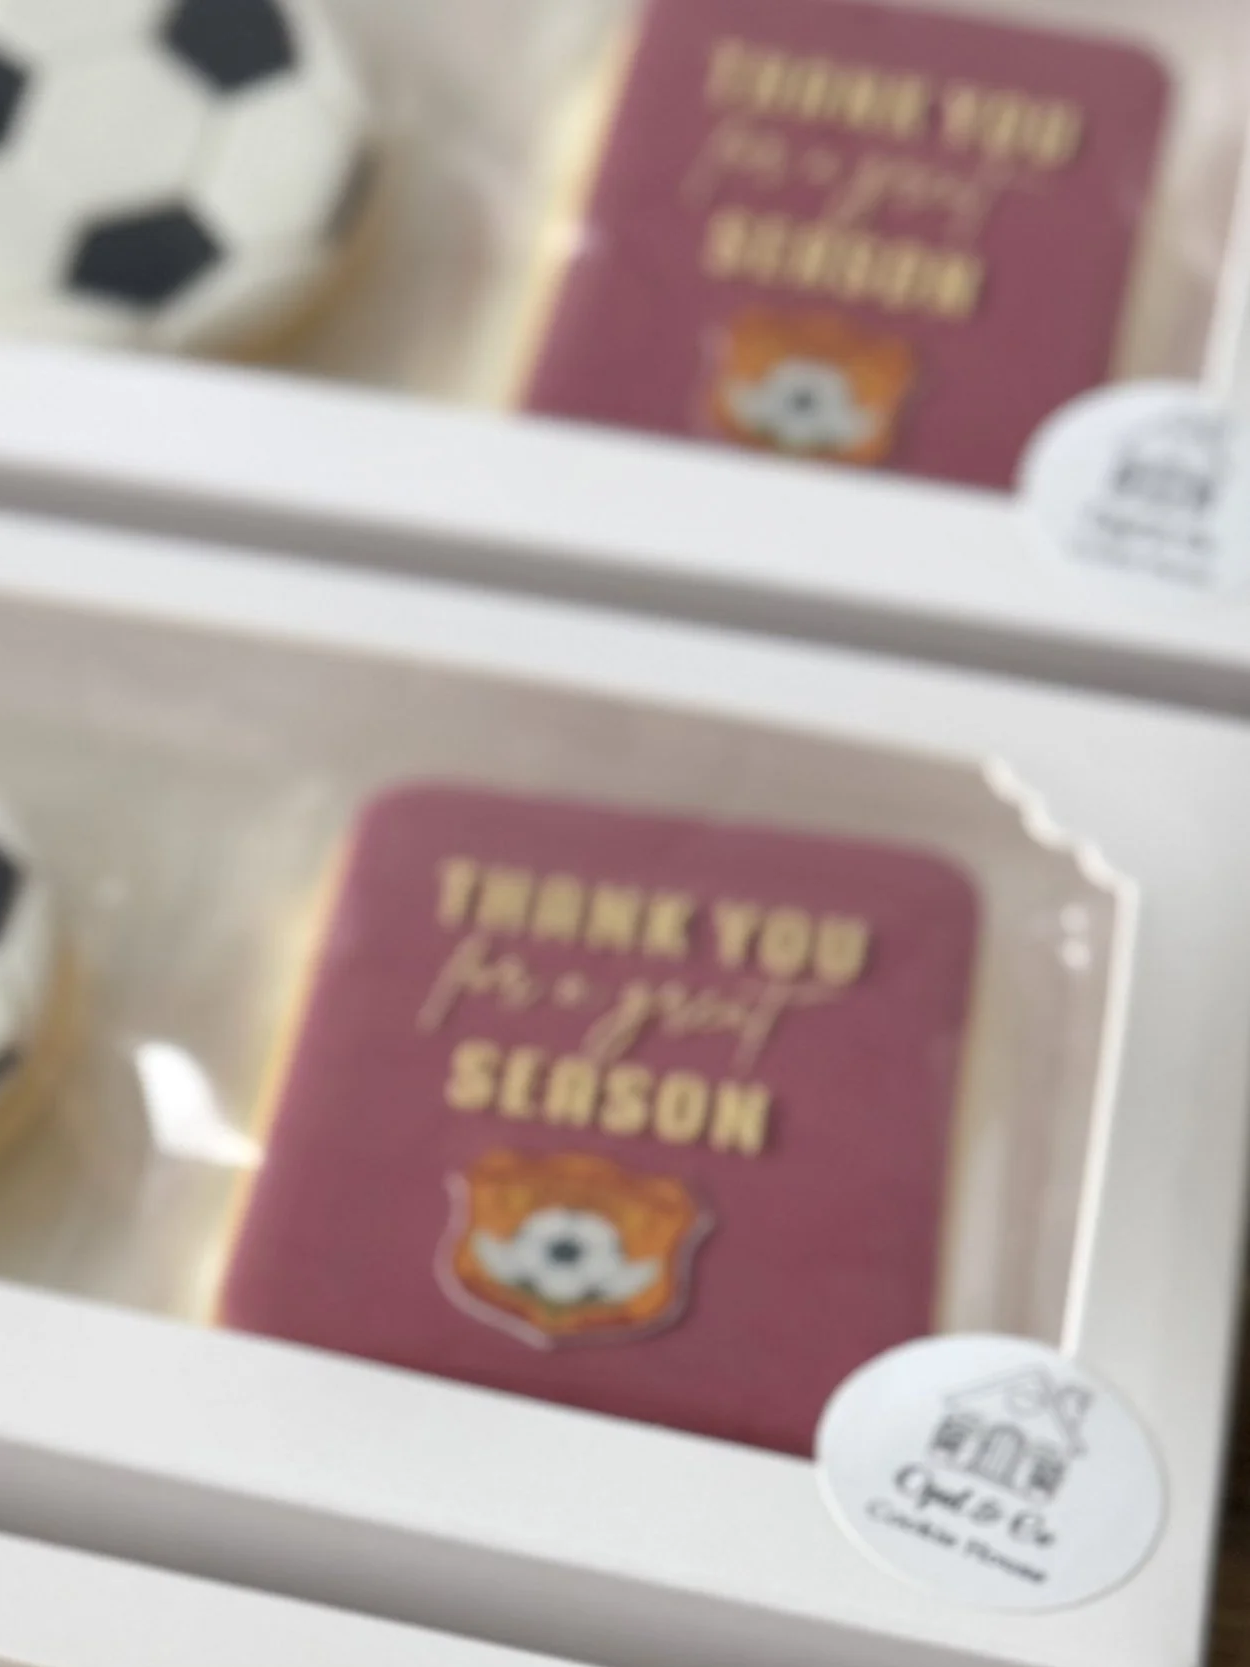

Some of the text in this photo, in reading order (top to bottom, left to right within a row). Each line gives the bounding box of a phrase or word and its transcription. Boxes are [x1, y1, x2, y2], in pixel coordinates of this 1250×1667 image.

[439, 857, 869, 986] THANK YOU
[447, 1038, 770, 1157] SEASON
